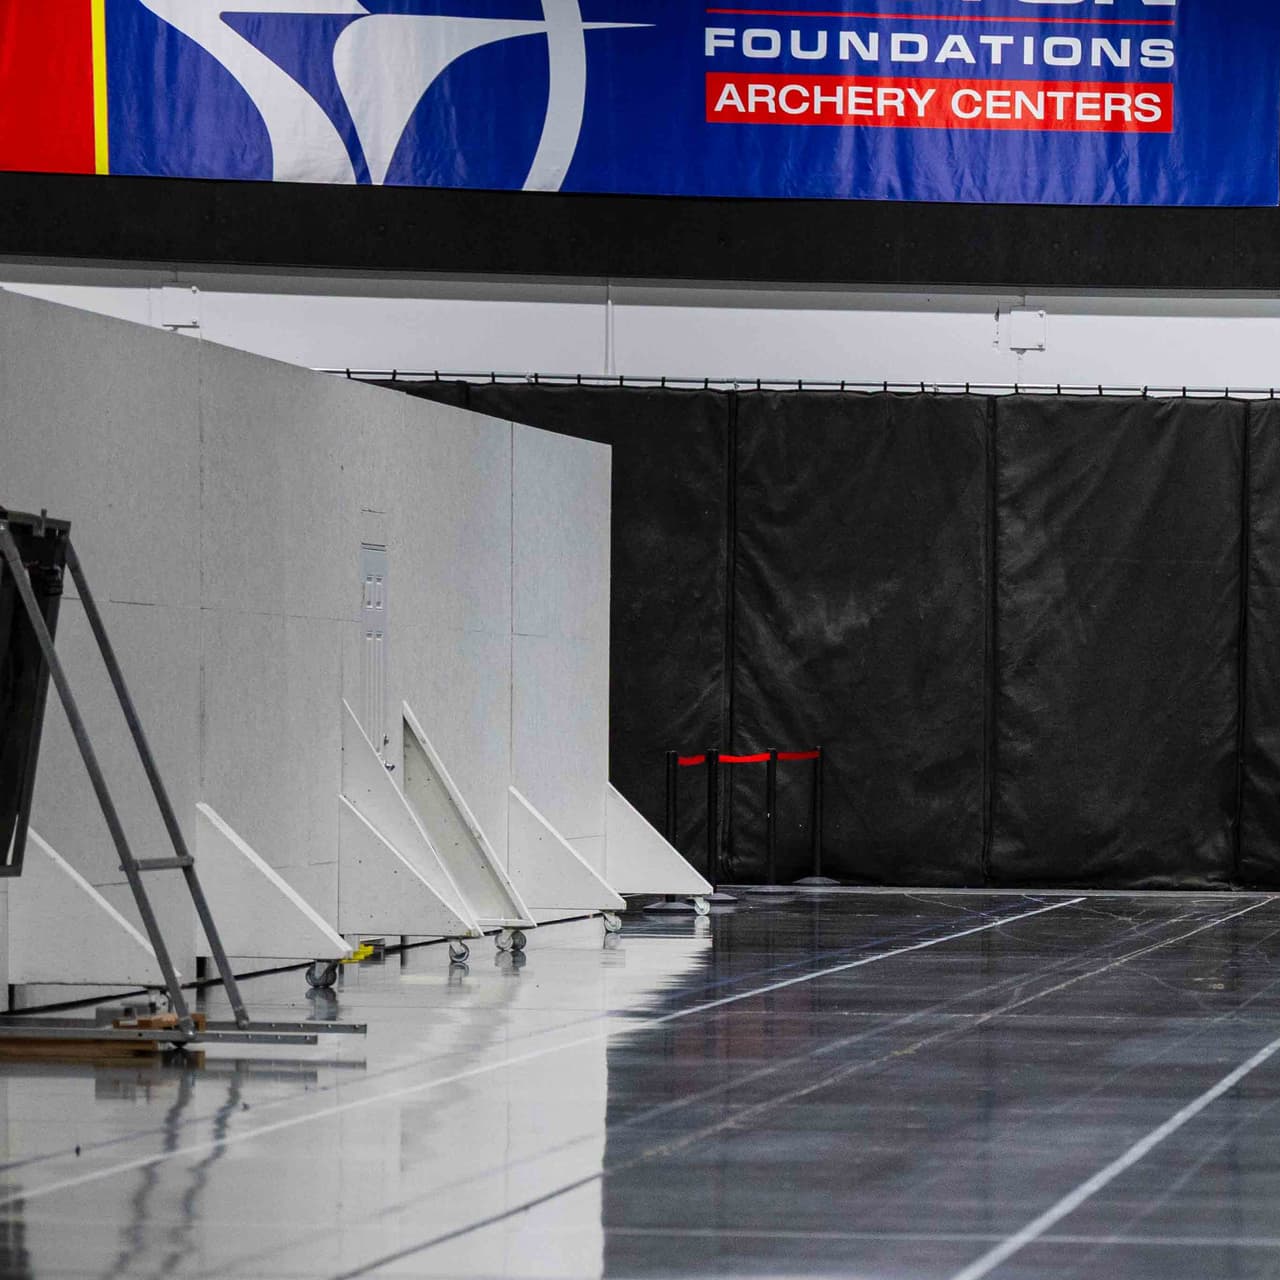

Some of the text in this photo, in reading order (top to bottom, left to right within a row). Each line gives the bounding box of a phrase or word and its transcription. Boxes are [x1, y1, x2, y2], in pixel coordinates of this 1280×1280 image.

[705, 27, 1174, 68] FOUNDATIONS
[714, 83, 1161, 122] ARCHERY CENTERS
